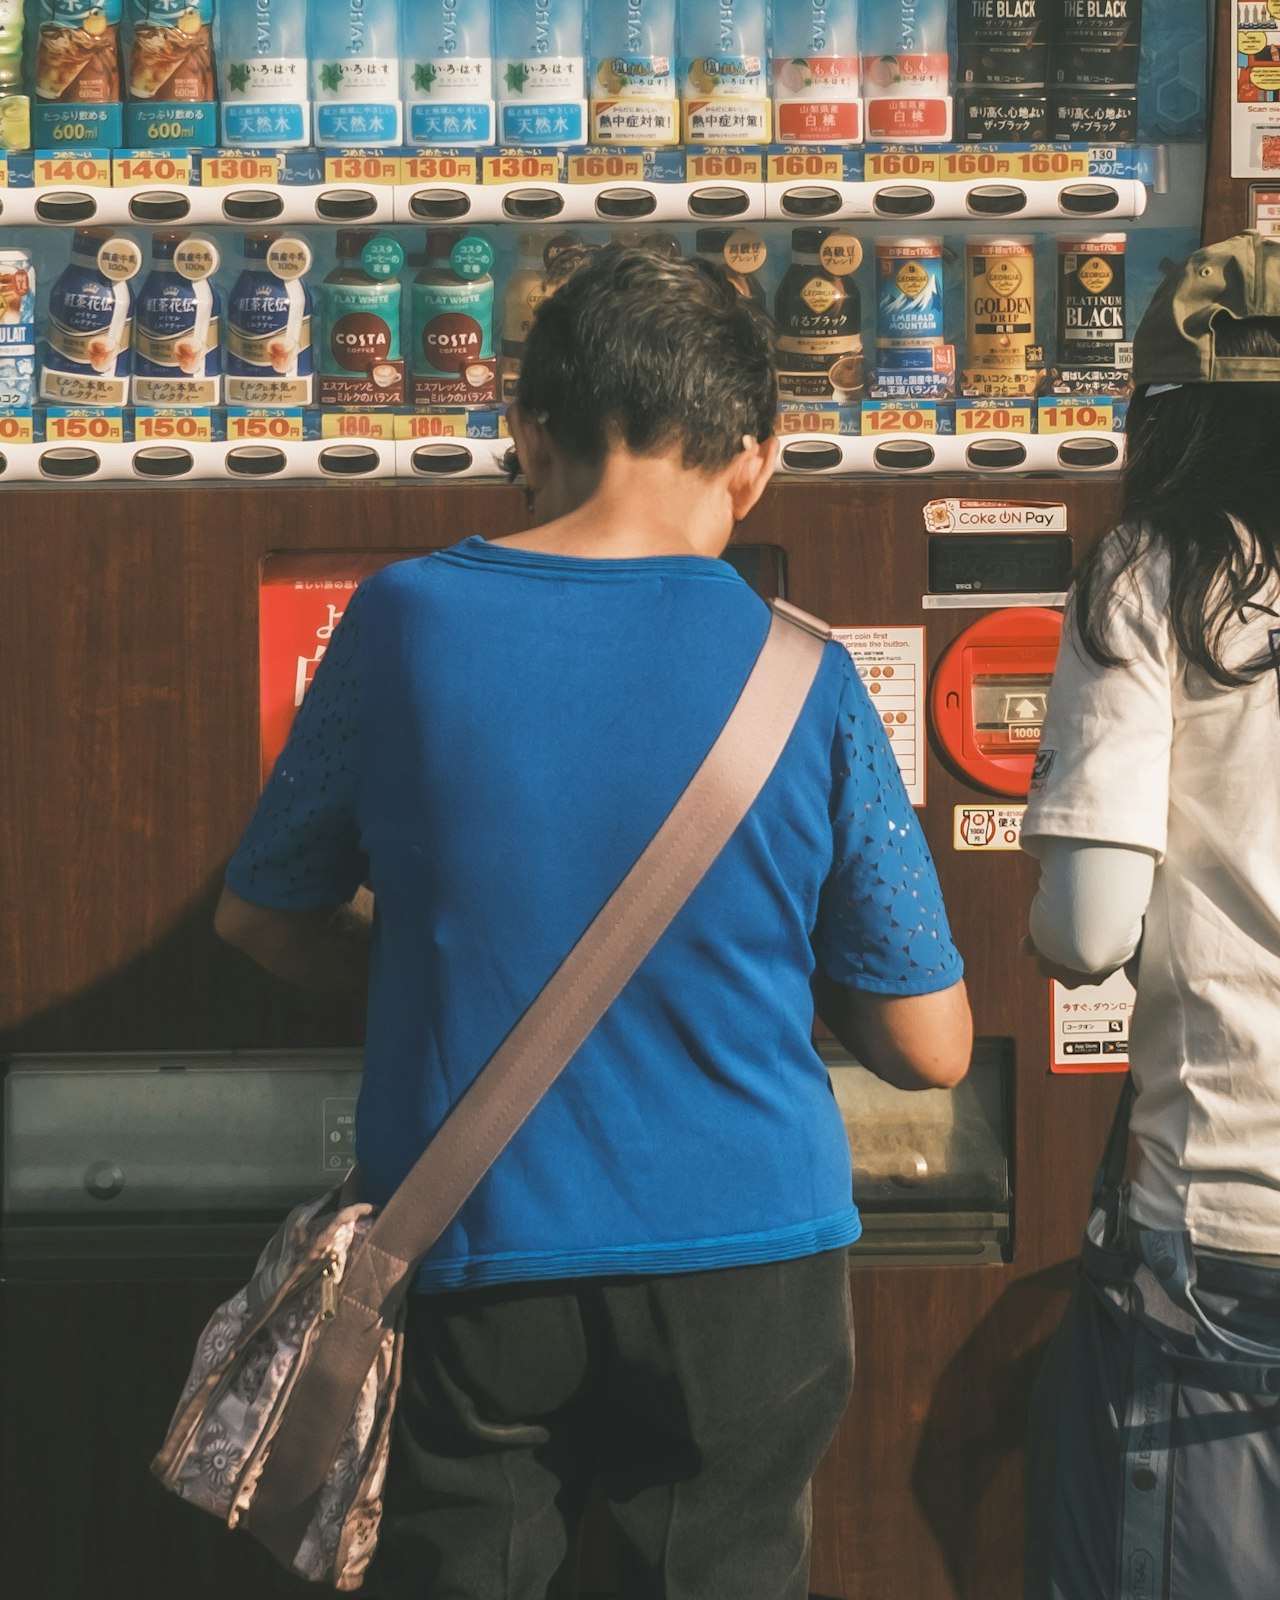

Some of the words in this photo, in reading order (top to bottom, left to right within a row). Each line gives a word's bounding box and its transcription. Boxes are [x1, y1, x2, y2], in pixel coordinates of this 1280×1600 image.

[972, 0, 994, 18] THE
[996, 0, 1036, 18] BLACK
[1064, 0, 1084, 18] THE
[1087, 0, 1127, 18] BLACK
[799, 103, 839, 114] 山梨県産
[969, 106, 1045, 120] 香り高く、心地よい
[240, 117, 291, 132] 天然水
[333, 116, 384, 131] 天然水
[599, 114, 671, 129] 熱中症対策!
[804, 113, 836, 128] 白桃
[1091, 149, 1113, 160] 130
[39, 160, 107, 181] 140円
[822, 246, 856, 257] 高級豆
[365, 254, 400, 264] コーヒーの
[824, 257, 854, 266] ブレンド
[64, 294, 116, 312] 紅茶花伝
[146, 297, 198, 313] 紅茶花伝
[974, 296, 1032, 316] GOLDEN
[1066, 295, 1123, 306] PLATINUM
[891, 313, 935, 322] EMERALD
[990, 314, 1020, 323] DRIP
[1066, 306, 1124, 327] BLACK
[889, 321, 937, 330] MOUNTAIN
[335, 332, 386, 347] COSTA
[427, 332, 478, 347] COSTA
[1062, 372, 1129, 381] 香ばしく深いコクで
[322, 382, 374, 392] エスプレッソと
[887, 385, 939, 395] 王道バランス
[336, 392, 401, 403] ミルクのバランス
[430, 391, 494, 402] ミルクのバランス
[866, 410, 933, 430] 120円
[960, 410, 1024, 429] 120円
[1043, 407, 1107, 426] 110円
[959, 512, 997, 525] Coke
[999, 510, 1022, 524] ON
[1025, 511, 1055, 527] Pay
[845, 641, 867, 649] press
[883, 641, 911, 649] button.
[1014, 728, 1040, 739] 1000
